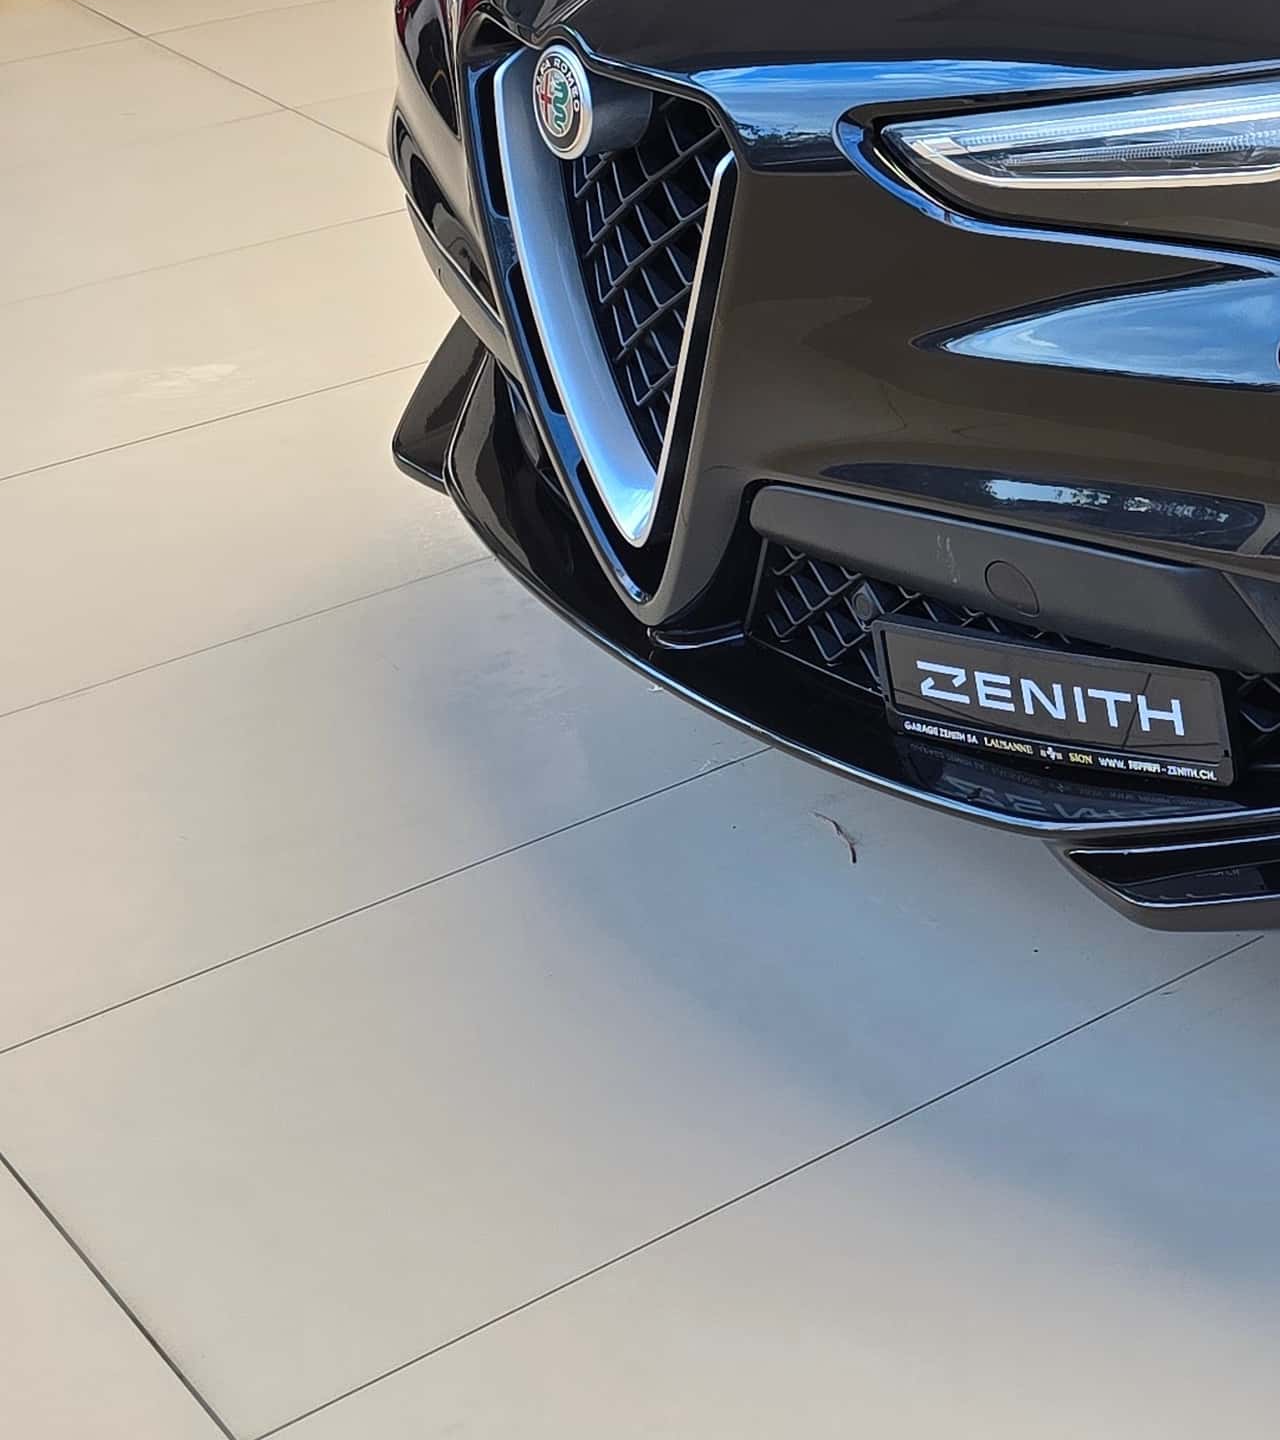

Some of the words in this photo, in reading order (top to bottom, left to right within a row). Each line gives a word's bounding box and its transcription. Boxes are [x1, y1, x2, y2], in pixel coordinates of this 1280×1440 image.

[554, 58, 580, 113] ROMEO
[916, 660, 1185, 736] ZENITH
[984, 736, 1034, 755] LAUSANNE
[1068, 752, 1093, 765] SION
